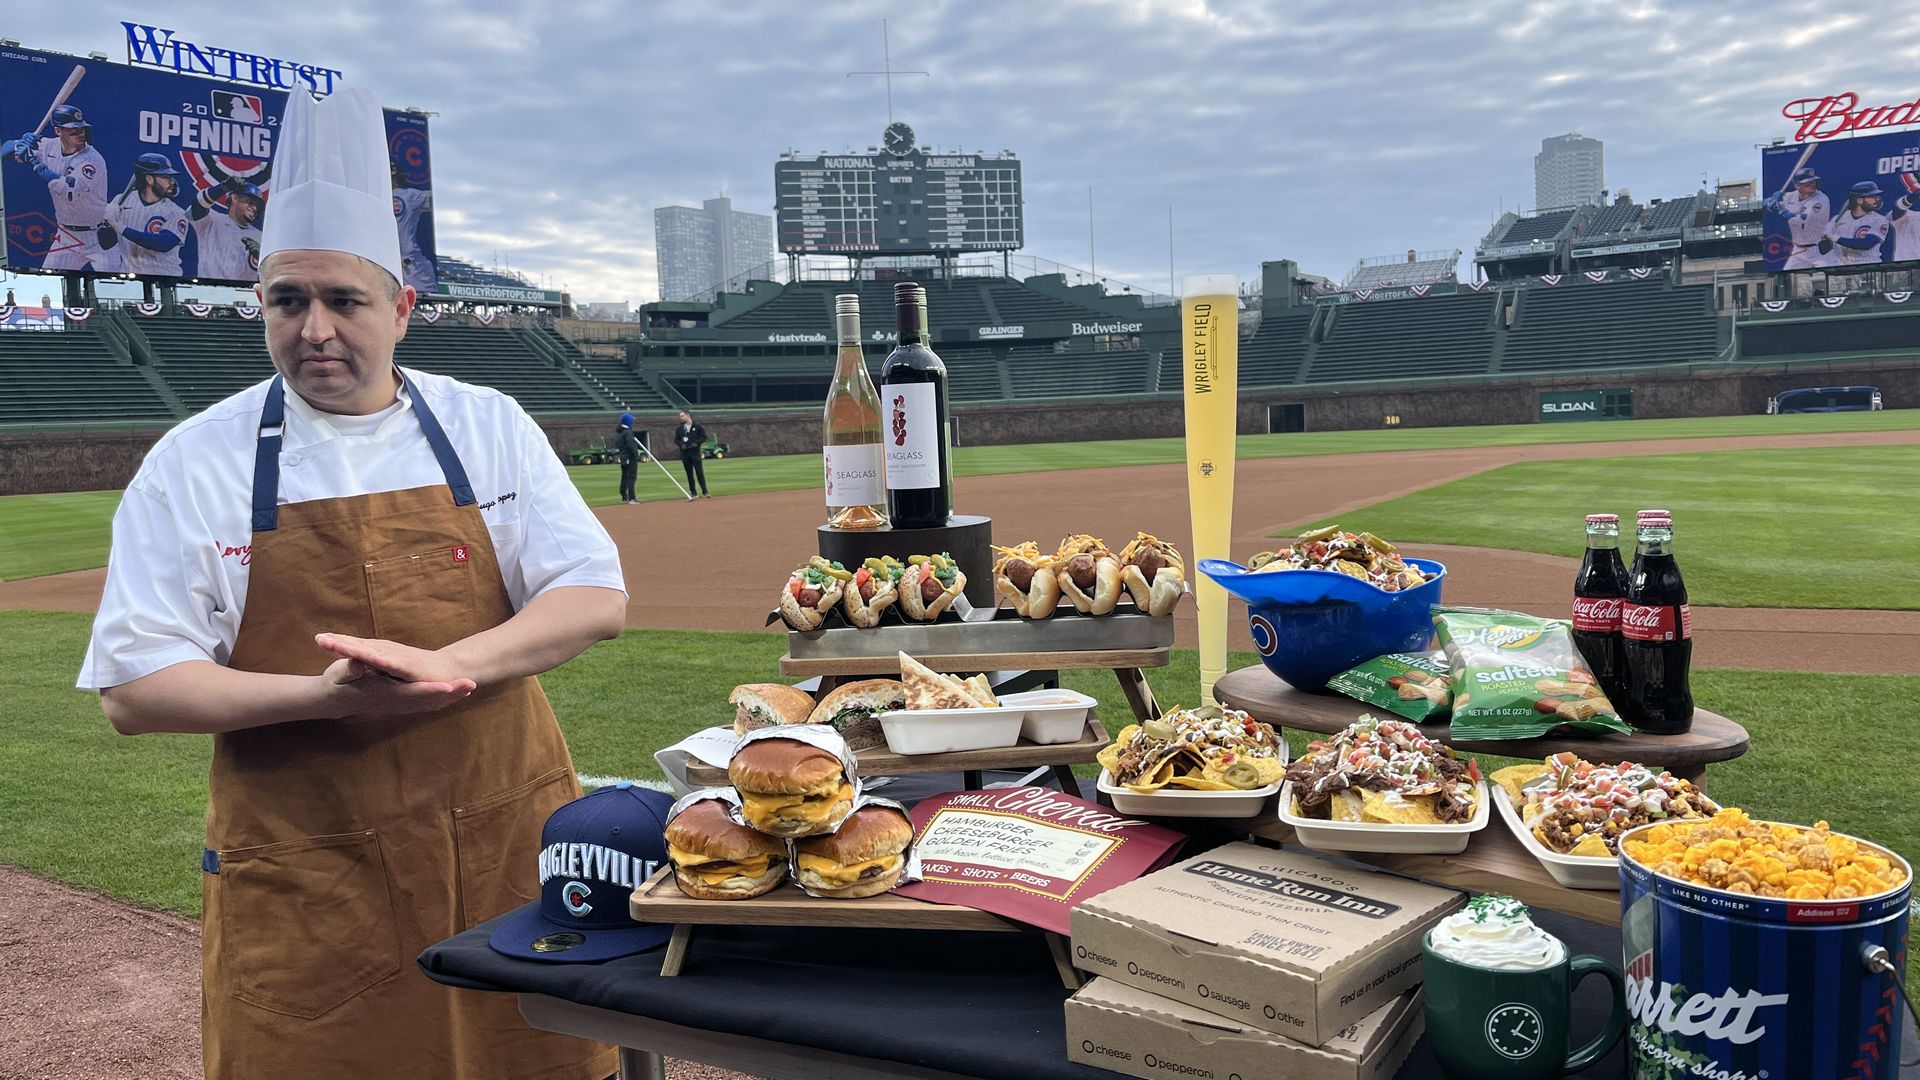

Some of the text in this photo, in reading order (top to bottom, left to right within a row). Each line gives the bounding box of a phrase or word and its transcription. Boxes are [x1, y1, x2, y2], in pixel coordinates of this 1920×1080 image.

[121, 21, 342, 96] WINTRUST
[183, 102, 207, 116] 20
[139, 110, 271, 158] OPENING
[824, 158, 875, 169] NATIONAL
[926, 157, 975, 168] AMERICAN
[448, 284, 545, 301] WRIGLEYROOFTOPS.COM
[979, 325, 1024, 335] GRAINGER
[1072, 321, 1143, 335] Budweiser
[1194, 303, 1213, 394] WRIGLEY FIELD
[1542, 402, 1594, 413] SLOAN
[836, 469, 877, 480] SEAGLASS
[479, 491, 517, 511] ugo opez
[1573, 597, 1621, 620] Coca-Cola
[1475, 664, 1558, 683] salted
[1480, 680, 1526, 691] ROASTED
[1502, 708, 1511, 716] OZ
[1512, 708, 1532, 716] (227g)
[948, 794, 996, 807] SMALL
[941, 816, 1034, 836] HAMBURGER
[926, 837, 1036, 856] GOLDEN FRIES
[933, 826, 1054, 848] CHEESEBURGER
[538, 842, 658, 891] RIGLEYVILLE
[921, 863, 1051, 887] AKES SHOTS BEERS
[1258, 865, 1359, 892] CHICAGO'S
[1191, 862, 1387, 916] Home Run Inn
[1207, 880, 1259, 903] PREMIUM
[1672, 888, 1745, 910] LIKE NO OTHER
[1154, 886, 1333, 936] AUTHENTIC CHICAGO THIN CRUST
[1797, 909, 1834, 917] Addison
[1243, 937, 1287, 951] SINCE
[1087, 950, 1306, 1028] cheese pepperoni sausage other
[1340, 991, 1356, 1008] Find
[1626, 973, 1790, 1045] arrett
[1095, 1043, 1214, 1080] cheese pepperoni
